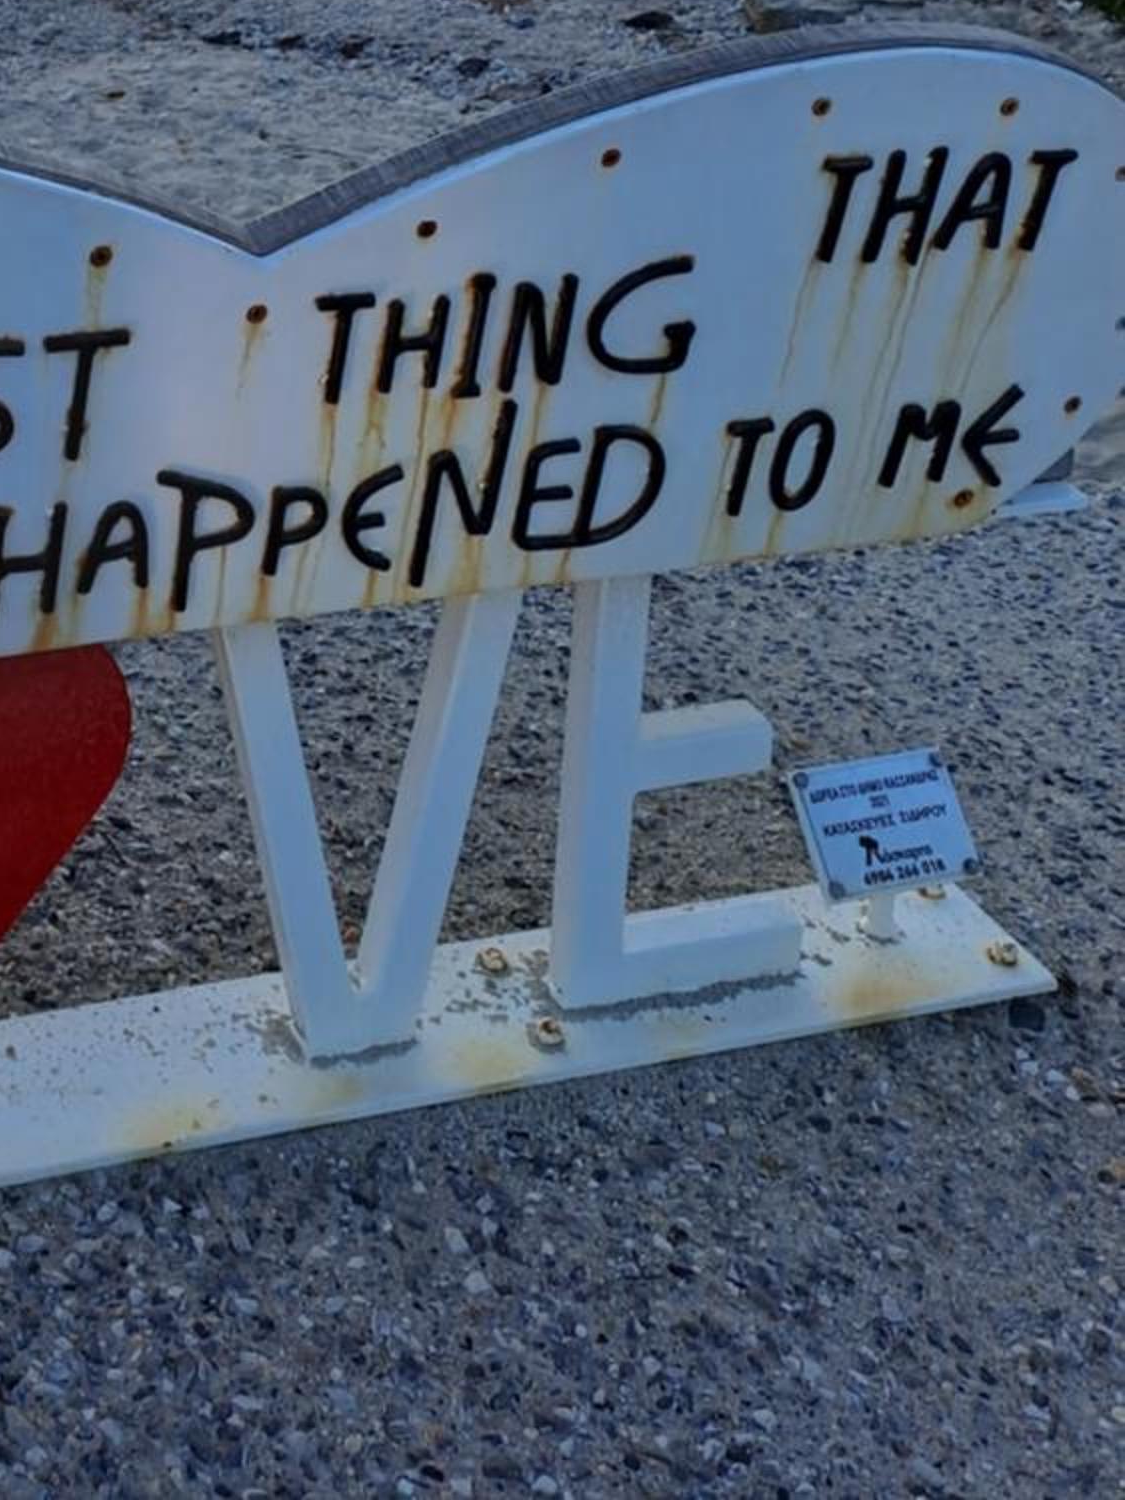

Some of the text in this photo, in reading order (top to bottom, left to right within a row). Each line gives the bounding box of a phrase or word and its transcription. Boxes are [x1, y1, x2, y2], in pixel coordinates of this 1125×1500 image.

[314, 254, 697, 406] THING
[815, 146, 1080, 266] THAT
[724, 408, 837, 517] TO
[876, 383, 1026, 488] ME
